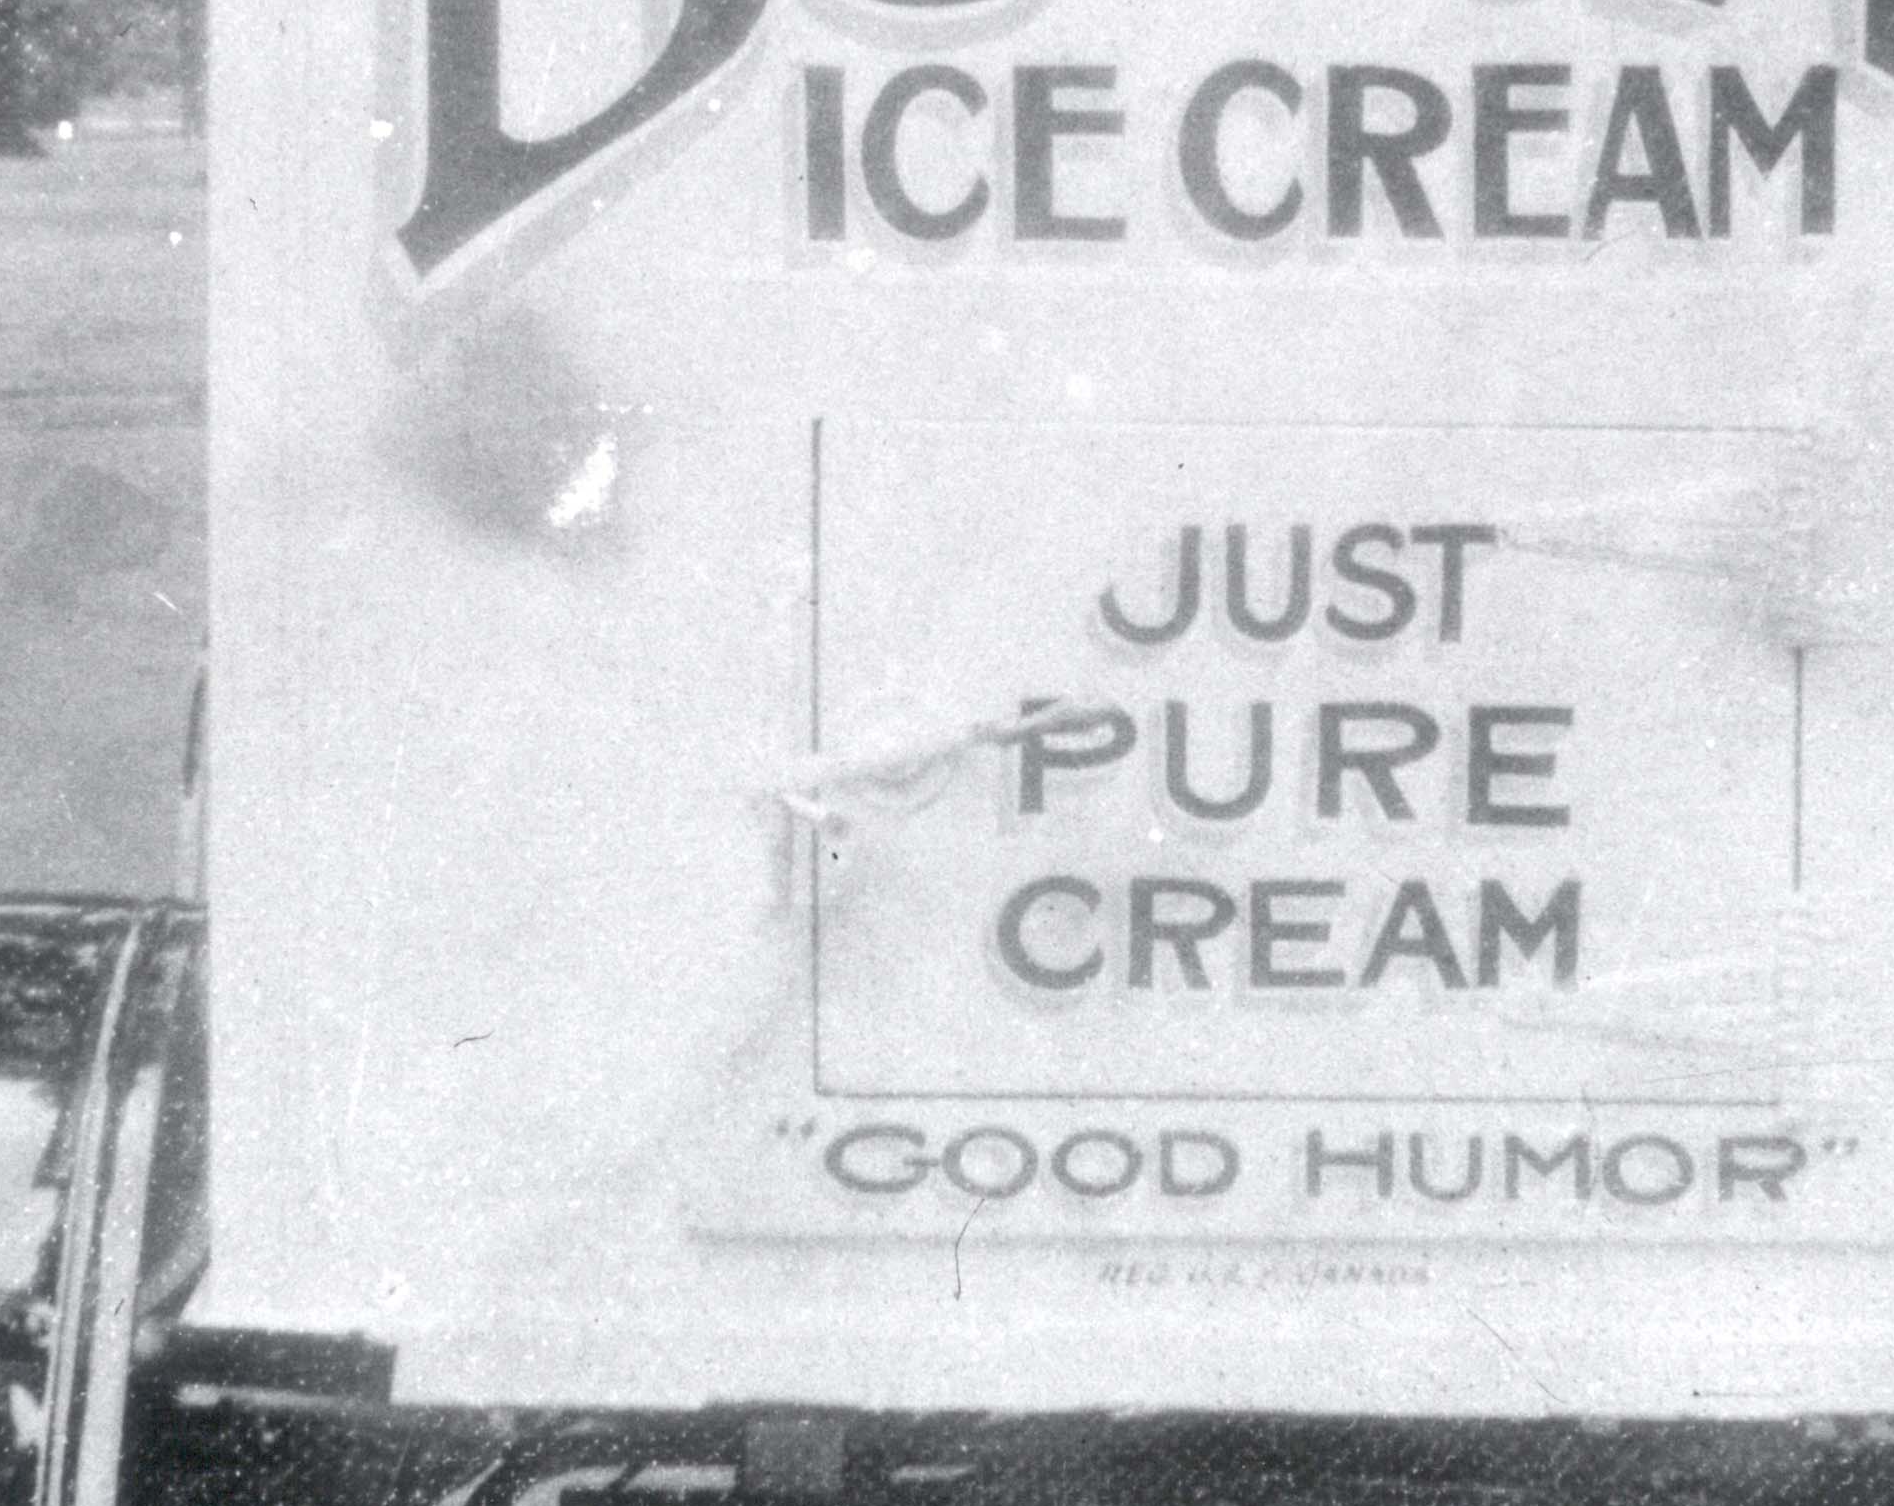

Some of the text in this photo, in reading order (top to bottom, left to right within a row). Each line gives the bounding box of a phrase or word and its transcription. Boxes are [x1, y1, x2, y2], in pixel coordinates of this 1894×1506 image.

[802, 58, 1841, 243] ICE CREAM
[1099, 523, 1498, 644] JUST
[1014, 697, 1576, 829] PURE
[997, 875, 1582, 990] CREAM
[774, 1117, 1859, 1207] "GOOD HUMOR"
